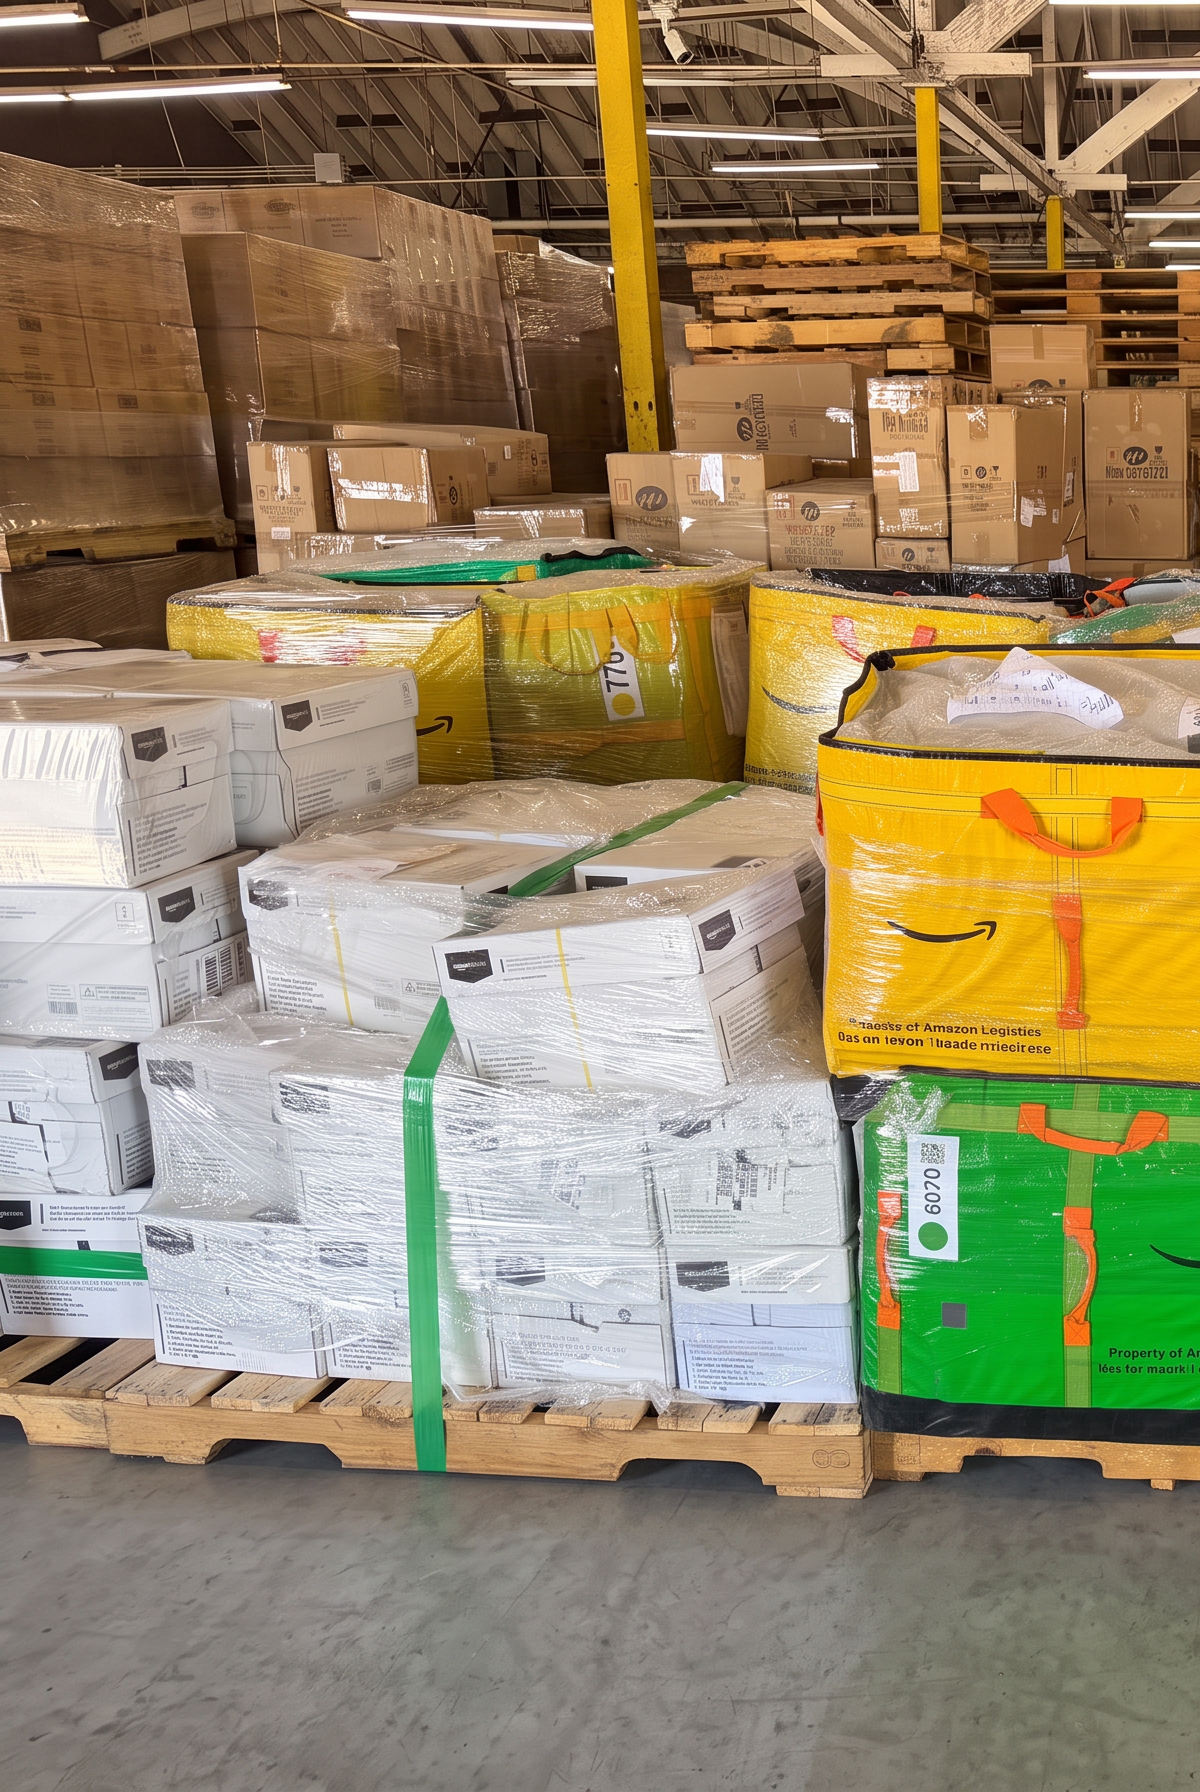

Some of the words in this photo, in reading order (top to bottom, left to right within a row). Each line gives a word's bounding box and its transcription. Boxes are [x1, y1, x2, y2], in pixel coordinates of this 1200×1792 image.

[923, 1022, 978, 1035] Amazon
[924, 1168, 942, 1215] 6070
[1109, 1347, 1166, 1361] Property
[1169, 1347, 1183, 1359] of
